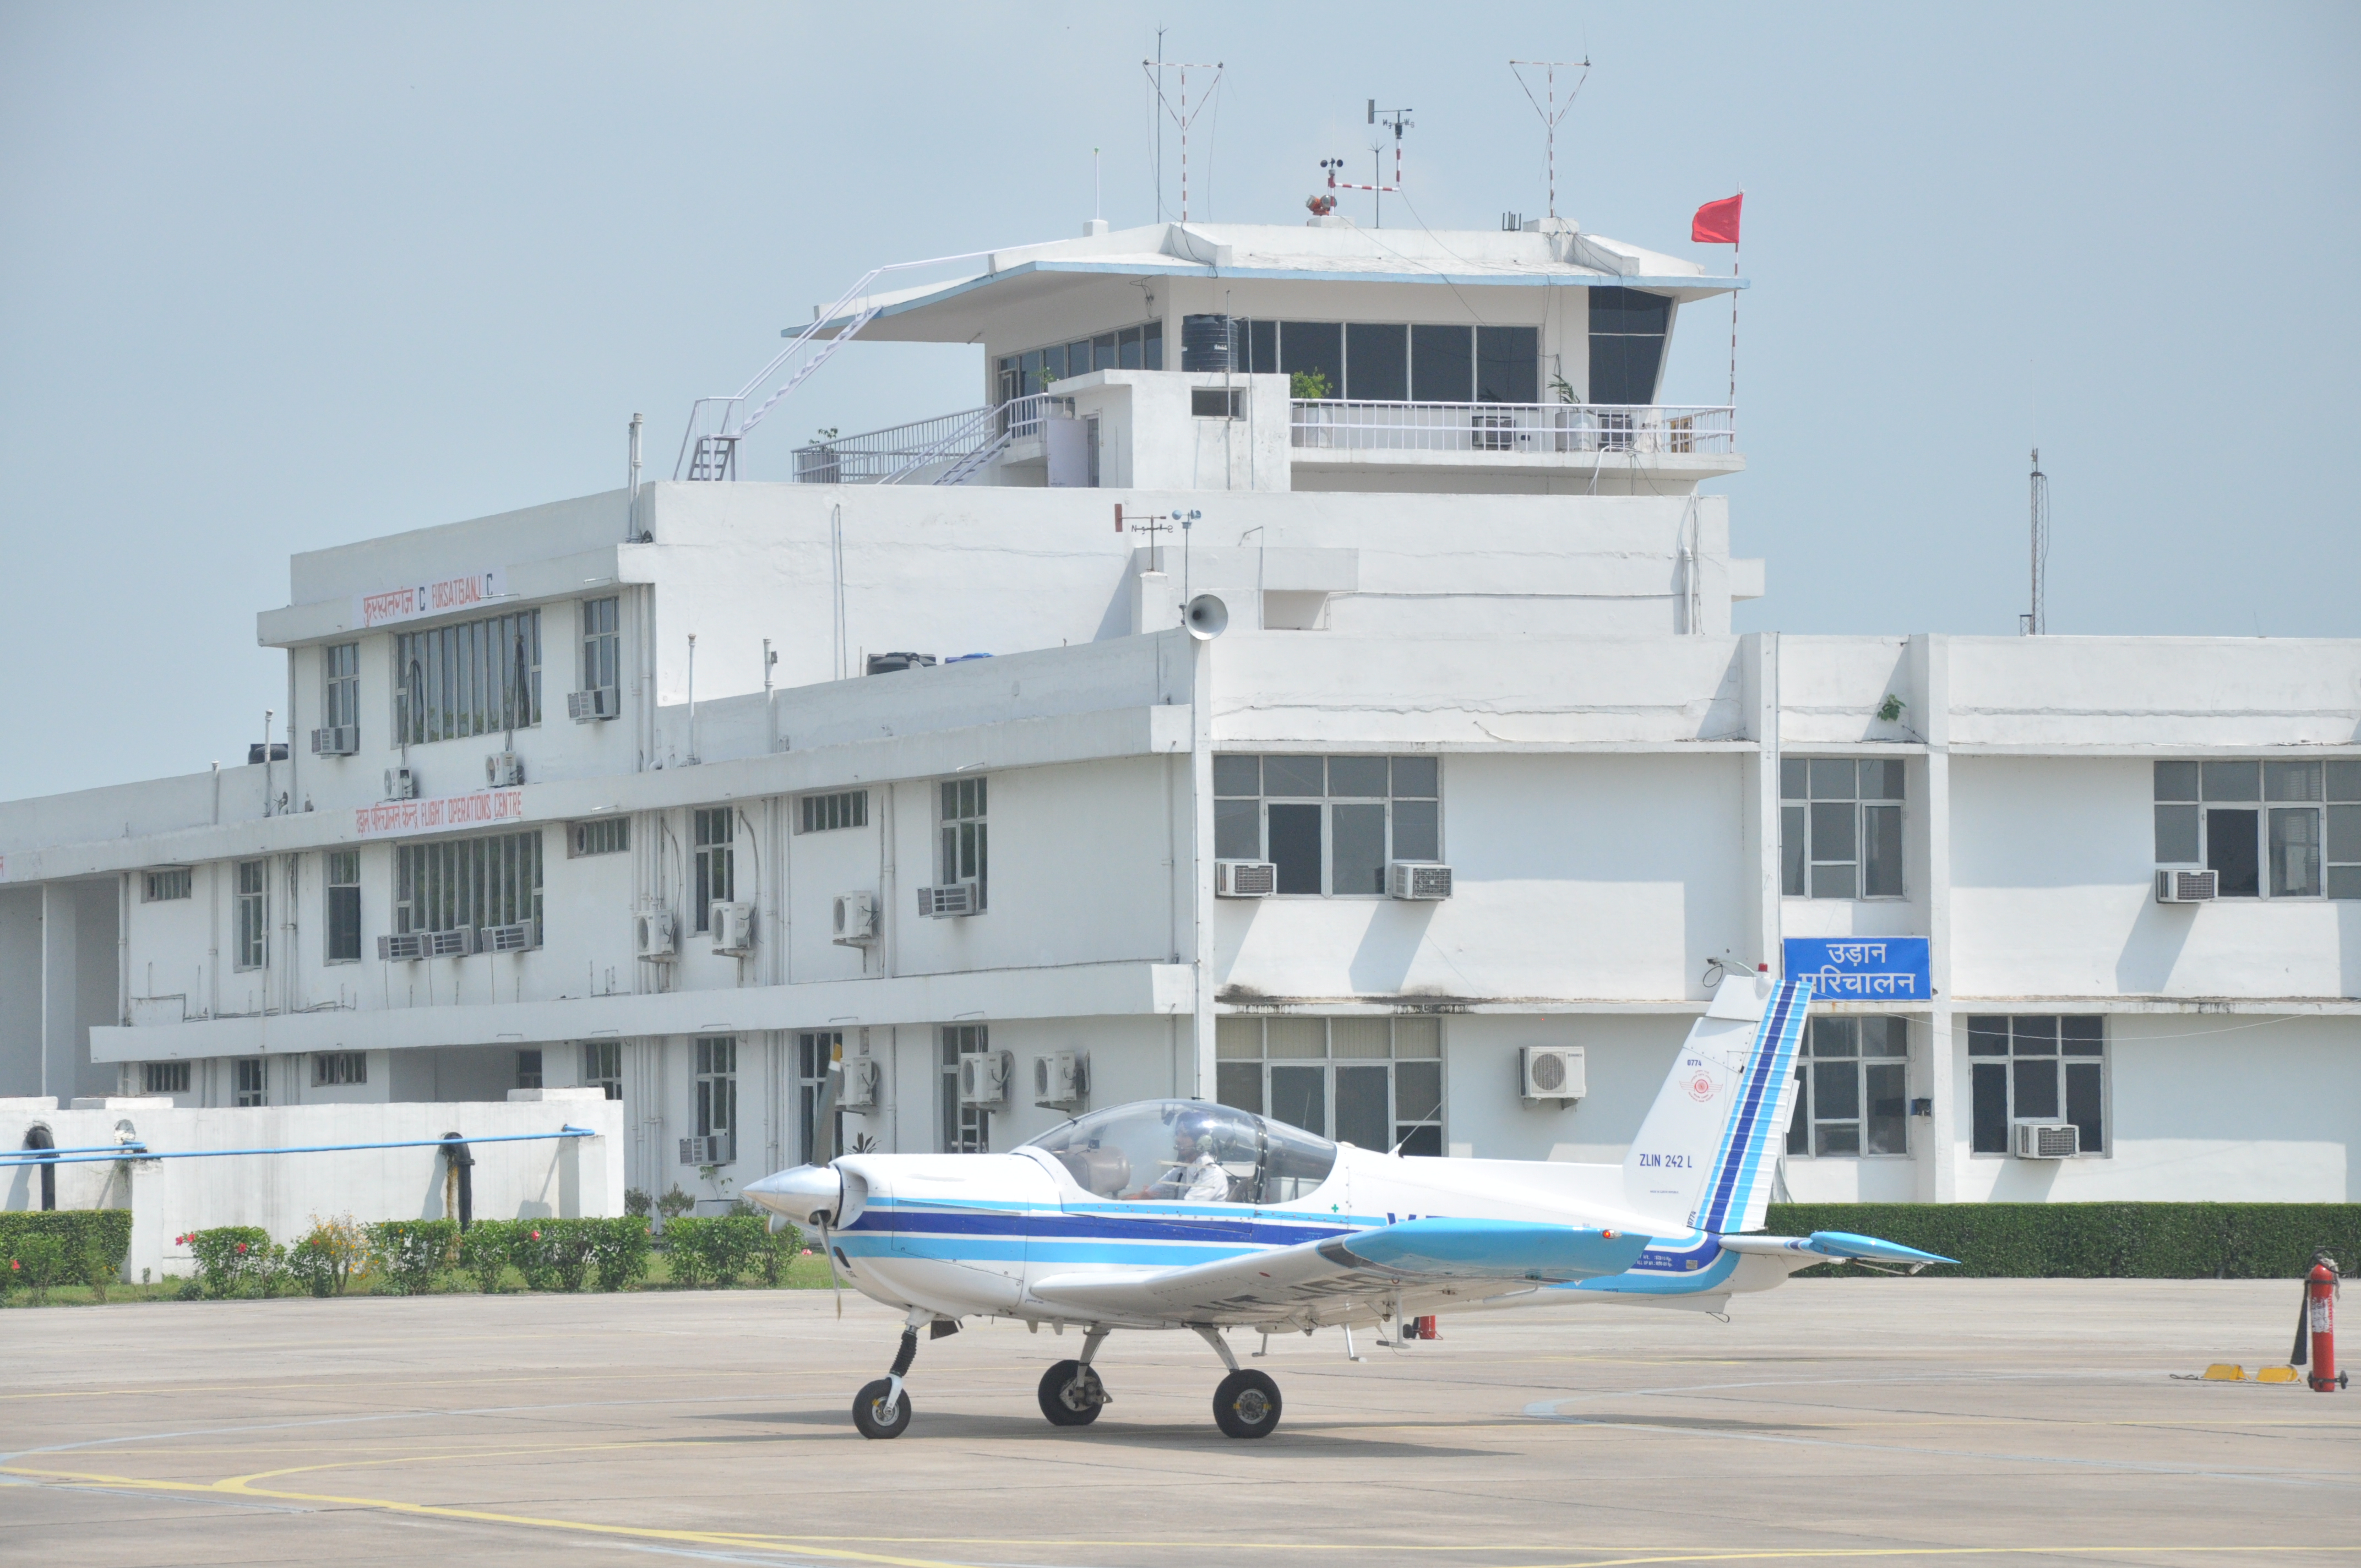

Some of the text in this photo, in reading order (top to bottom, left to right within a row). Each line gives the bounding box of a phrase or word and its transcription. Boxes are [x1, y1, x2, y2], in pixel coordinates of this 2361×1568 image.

[419, 586, 425, 611] C
[432, 575, 481, 609] FURSATGANJ
[487, 573, 493, 599] C
[421, 800, 444, 826] FLIGHT
[448, 794, 491, 824] OPERATIONS
[494, 792, 521, 817] CENTRE
[1826, 943, 1886, 967] उड़ान
[1798, 965, 1916, 994] परिचालन
[1640, 1154, 1692, 1168] ZLIN 242 L
[1687, 1211, 1696, 1226] 0774
